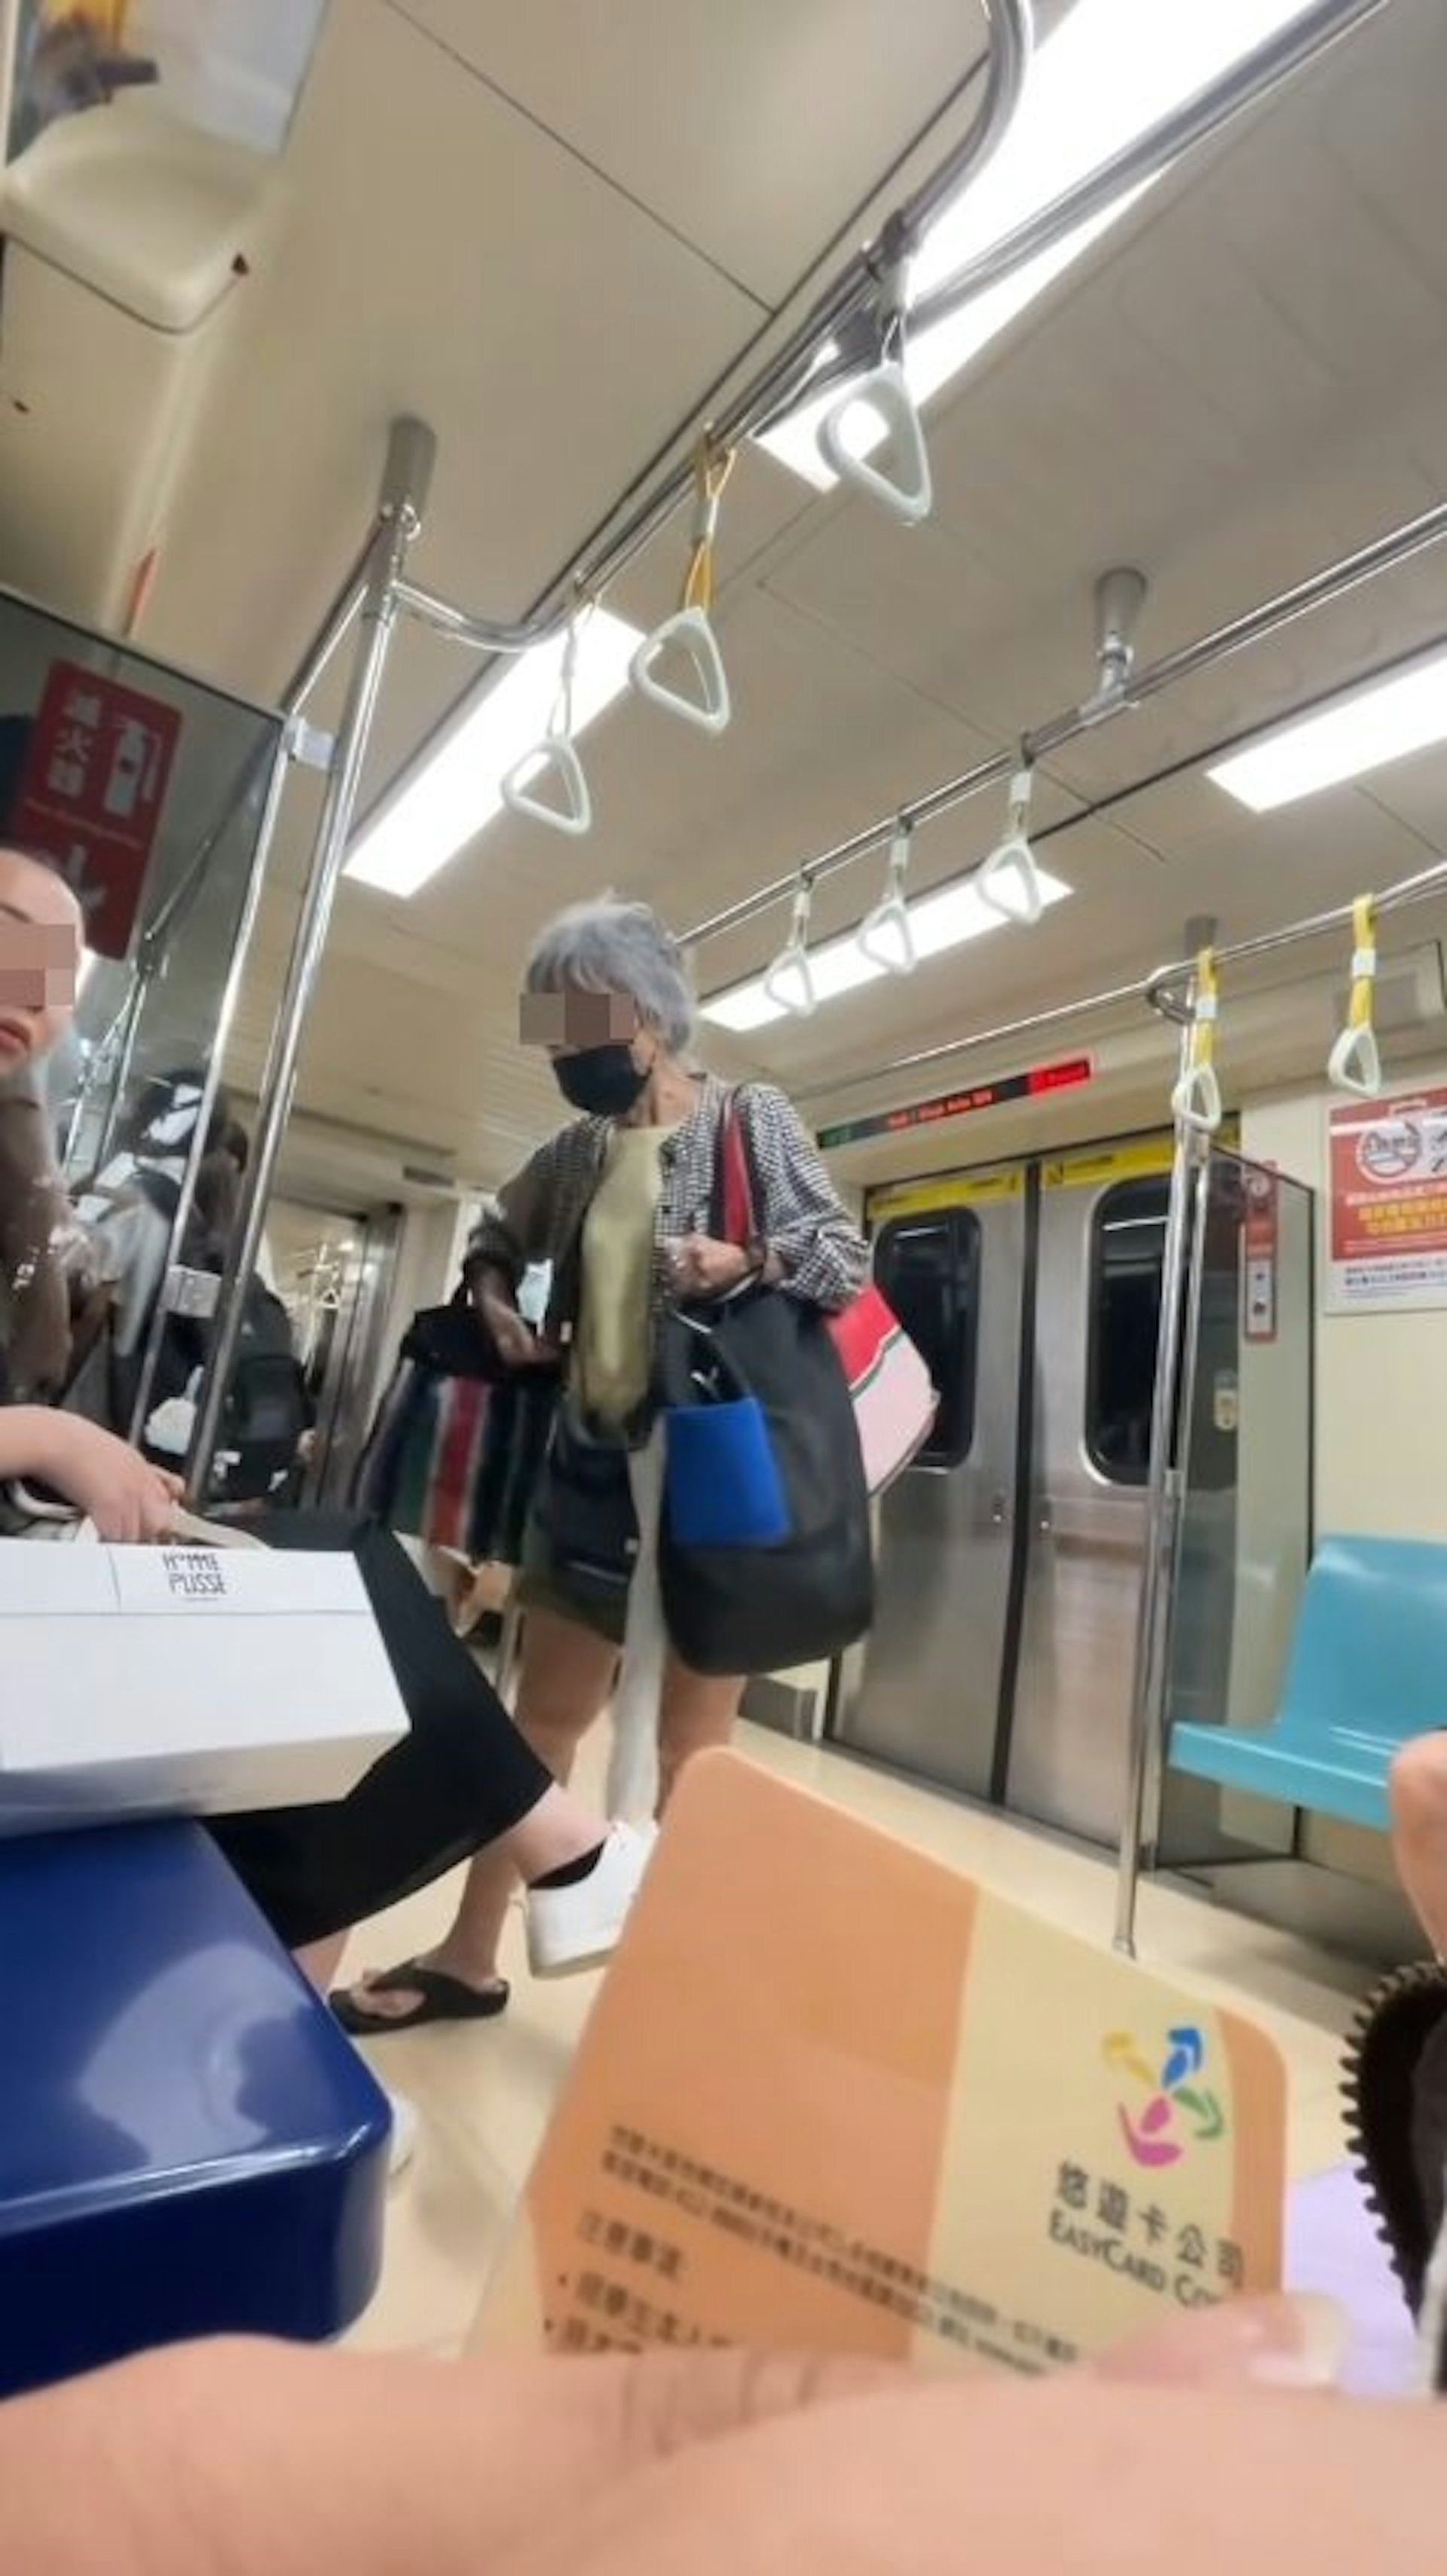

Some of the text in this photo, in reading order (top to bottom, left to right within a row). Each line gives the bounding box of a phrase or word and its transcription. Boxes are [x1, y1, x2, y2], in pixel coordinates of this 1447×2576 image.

[1058, 2159, 1245, 2290] 悠遊卡公司
